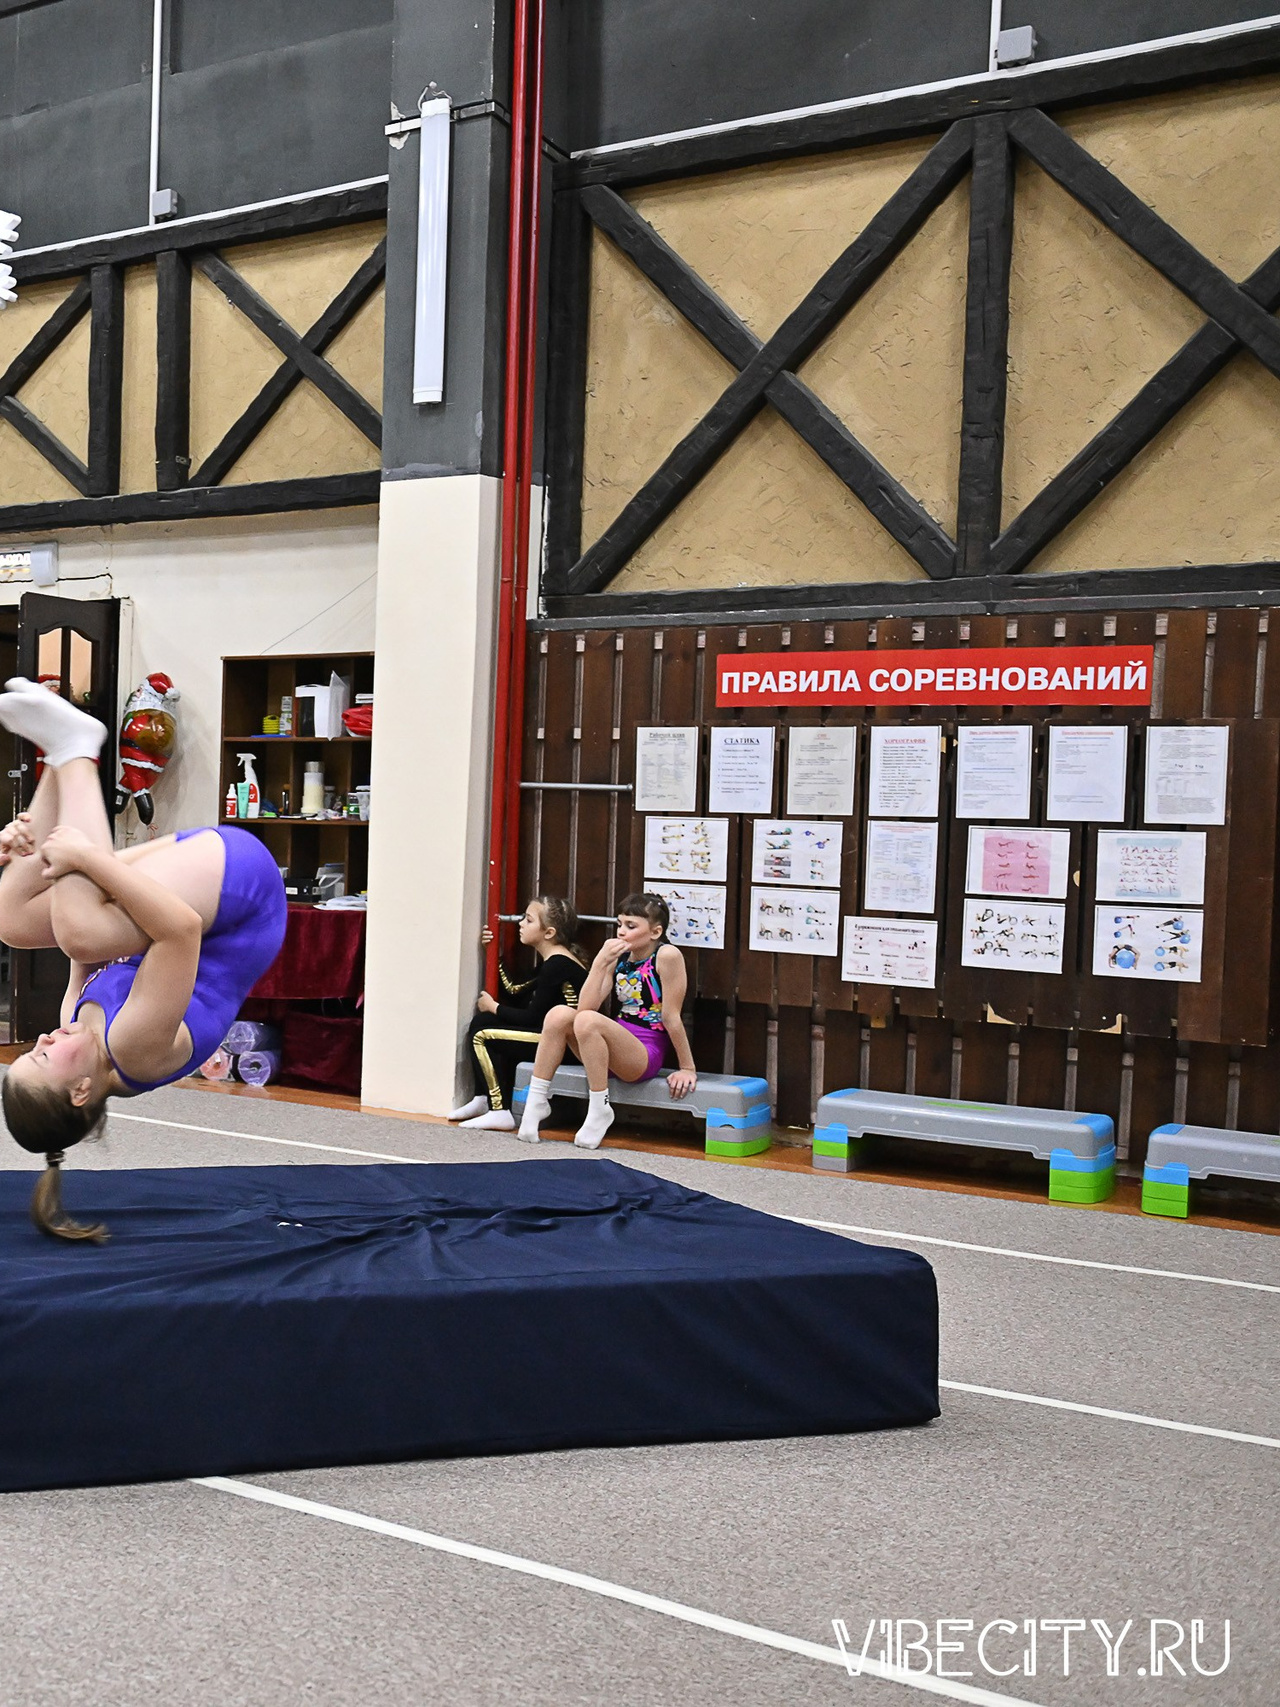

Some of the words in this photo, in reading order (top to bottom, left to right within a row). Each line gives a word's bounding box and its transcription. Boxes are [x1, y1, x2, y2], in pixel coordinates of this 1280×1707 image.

[722, 669, 862, 694] ПРАВИЛА
[868, 660, 1148, 693] СОРЕВНОВАНИЙ
[723, 737, 761, 745] СТАТИКА
